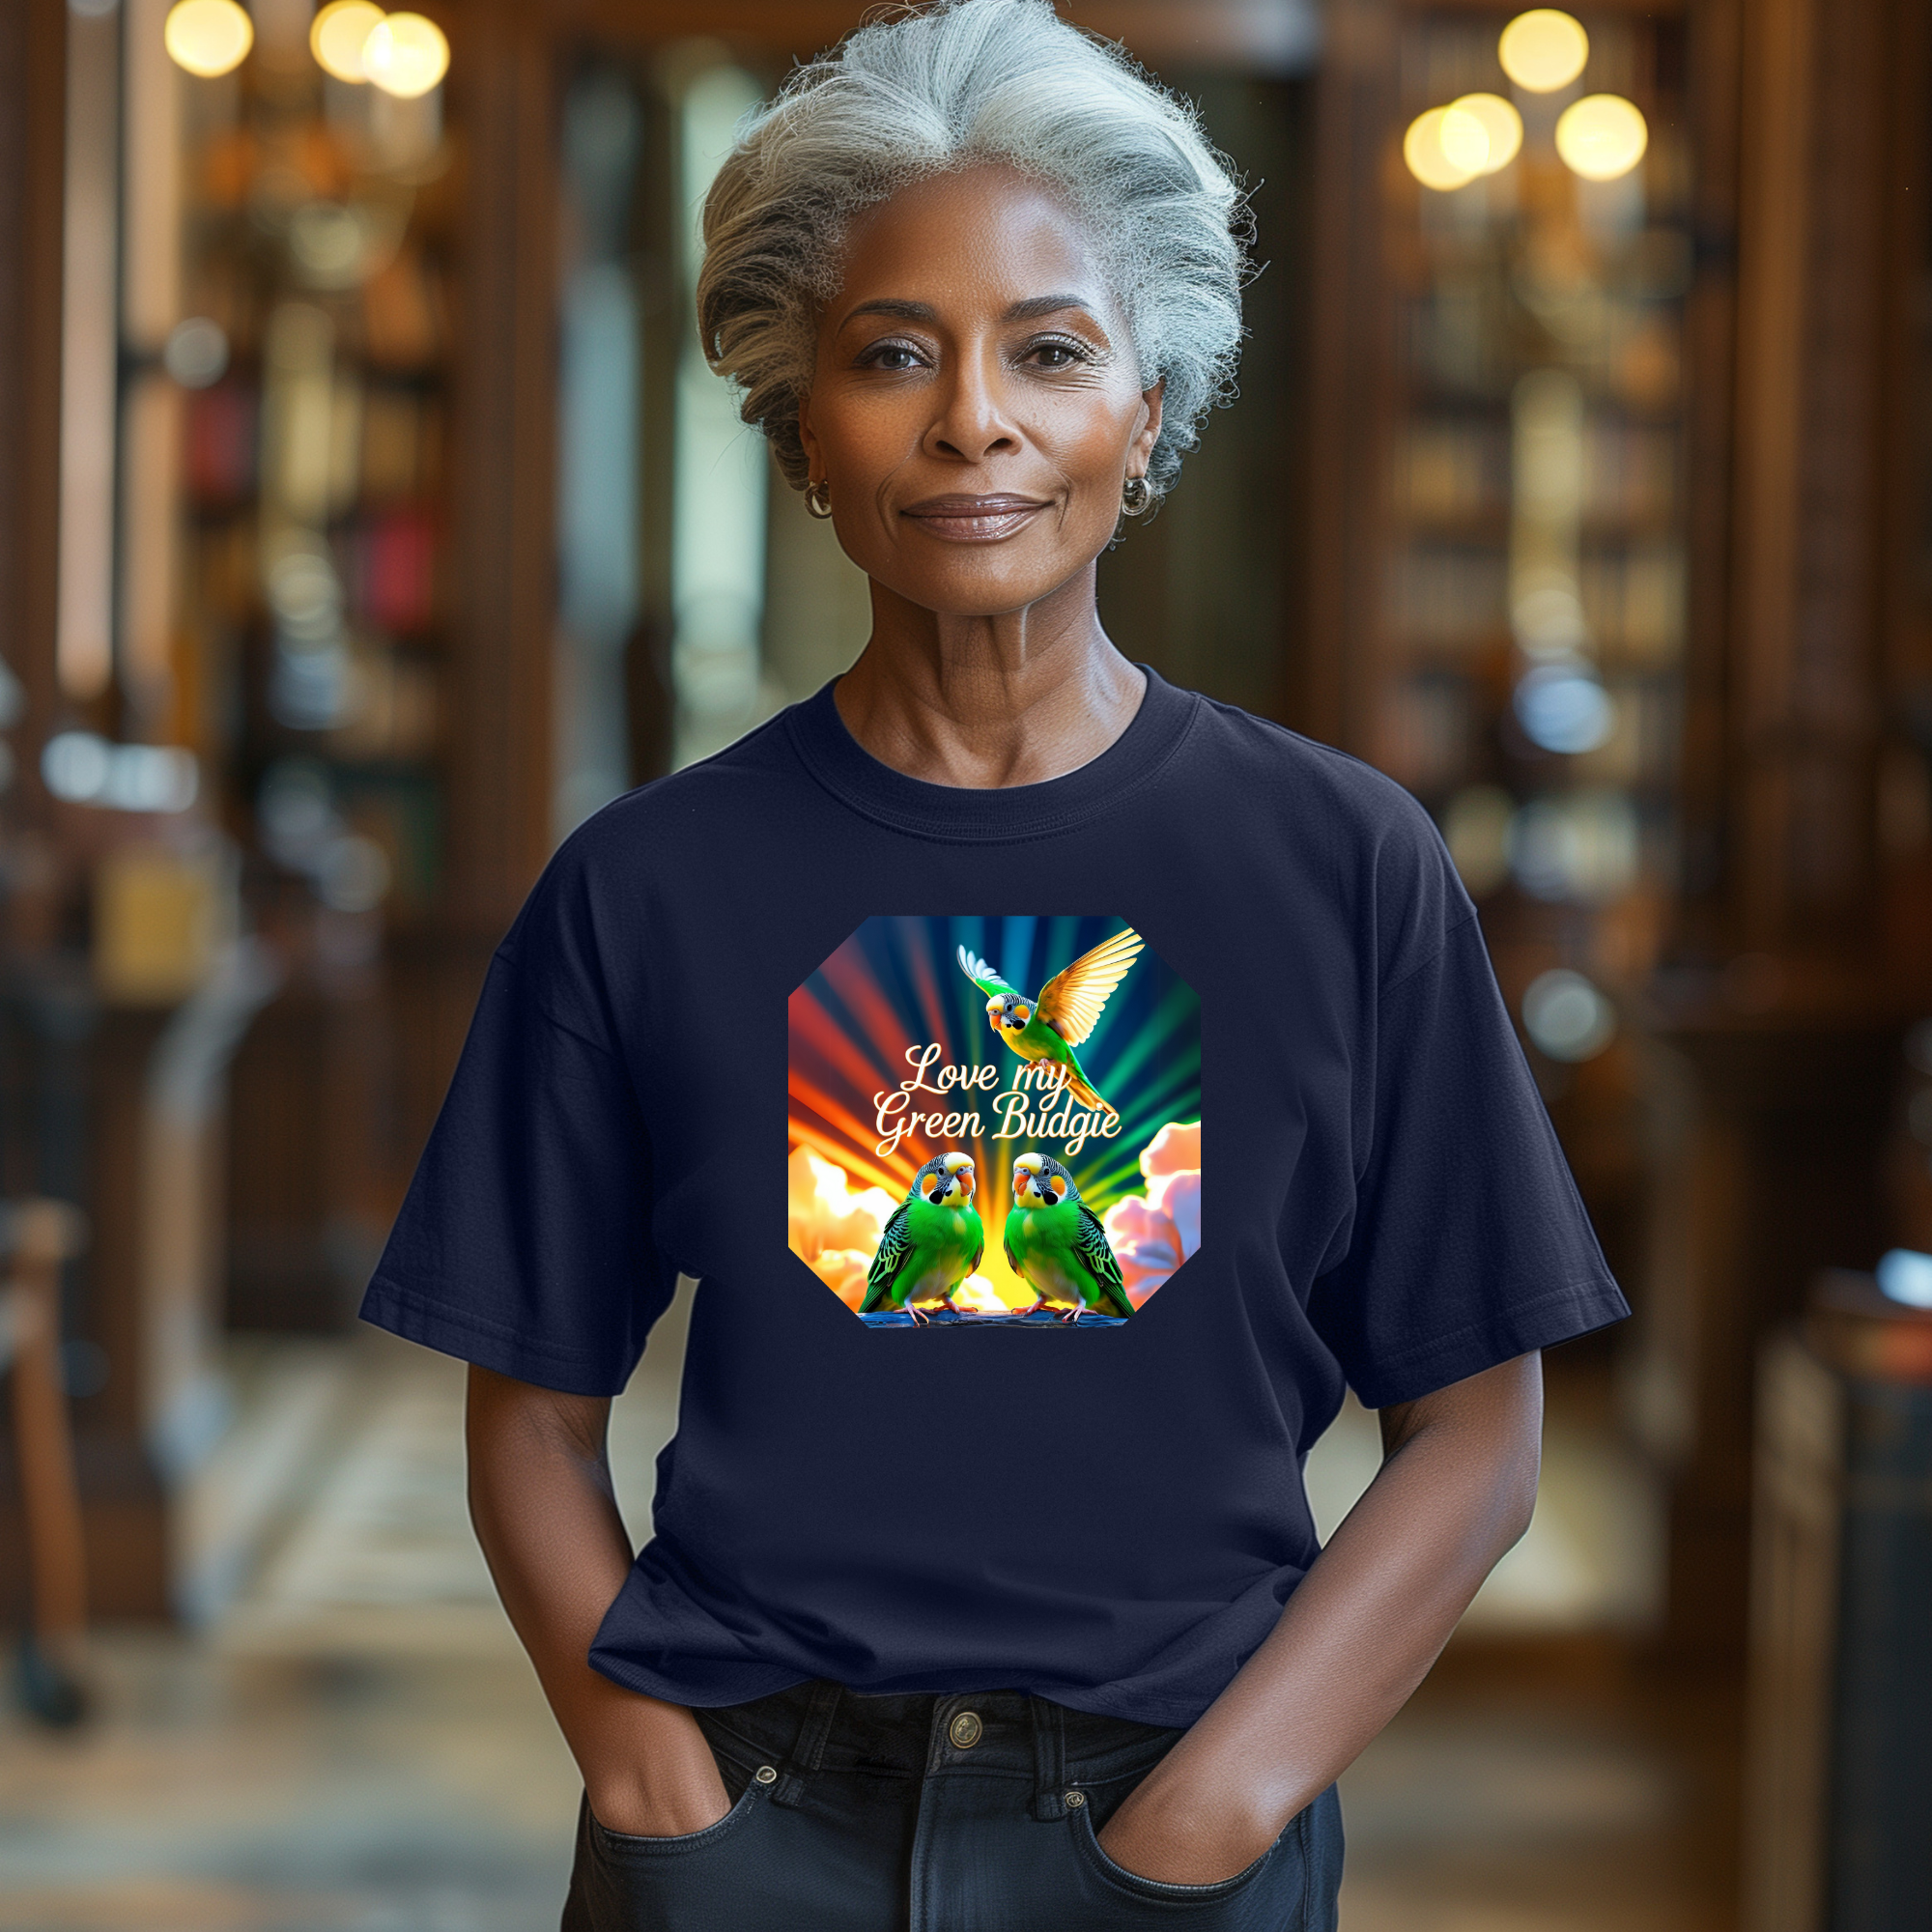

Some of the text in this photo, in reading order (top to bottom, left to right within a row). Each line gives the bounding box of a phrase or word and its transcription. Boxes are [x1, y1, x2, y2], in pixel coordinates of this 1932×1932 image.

[899, 1042, 1072, 1112] Love my
[873, 1091, 1122, 1157] Green Budgie
